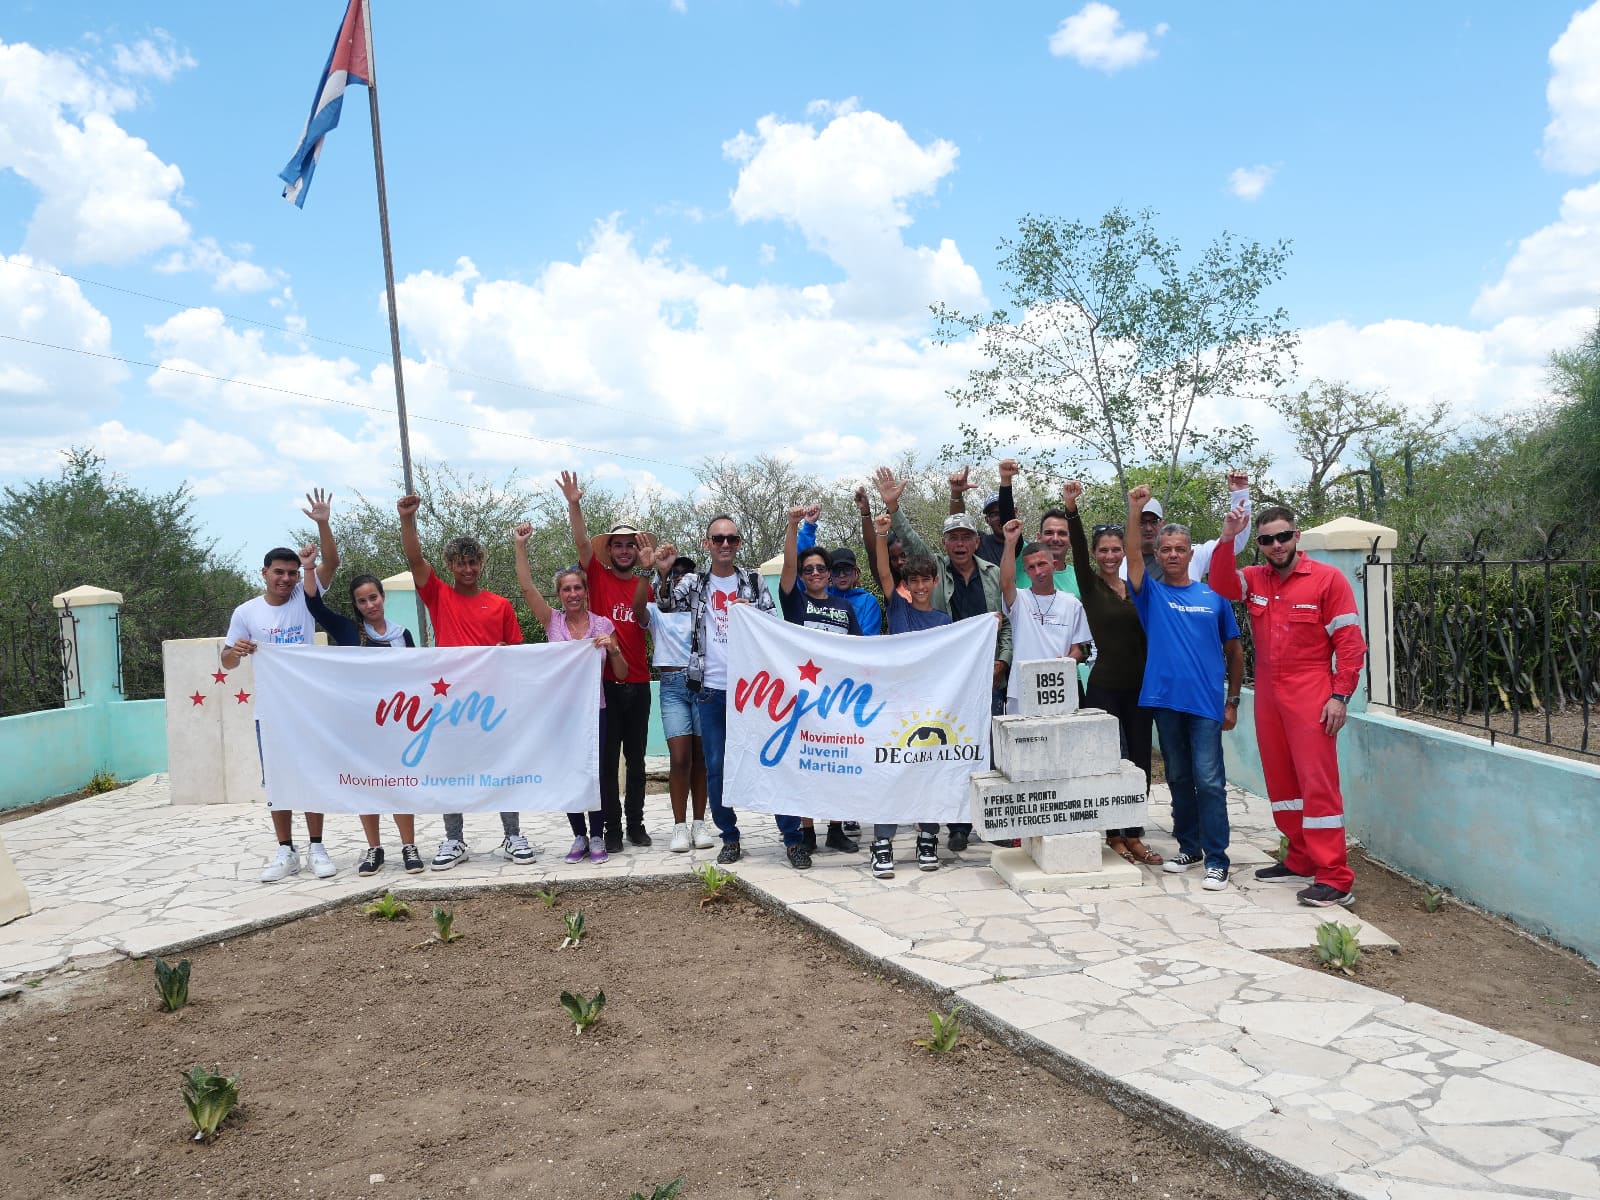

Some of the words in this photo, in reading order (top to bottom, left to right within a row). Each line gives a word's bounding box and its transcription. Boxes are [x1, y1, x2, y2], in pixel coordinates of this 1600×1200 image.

[1036, 672, 1064, 688] 1895
[1037, 689, 1064, 704] 1995
[735, 659, 887, 768] mjm
[375, 677, 508, 768] mjm
[800, 729, 865, 745] Movimiento
[800, 745, 848, 759] Juvenil
[875, 747, 901, 764] DE
[903, 751, 933, 765] CARA
[800, 758, 863, 775] Martiano
[339, 773, 419, 787] Movimiento
[421, 774, 475, 787] Juvenil
[479, 774, 543, 787] Martiano
[984, 797, 989, 806] Y
[991, 794, 1014, 804] PENSE
[1016, 793, 1026, 802] DE
[1028, 790, 1057, 801] PRONTO
[984, 809, 1002, 817] ANTE
[1005, 803, 1038, 816] AQUELLA
[1040, 800, 1081, 812] HERMOSURA
[1083, 798, 1094, 808] EN
[1095, 797, 1109, 806] LAS
[1111, 794, 1145, 805] PASIONES
[984, 817, 1009, 830] BAJAS
[1010, 816, 1016, 827] Y
[1018, 813, 1052, 826] FEROCES
[1053, 811, 1068, 823] DEL
[1070, 809, 1099, 821] HOMBRE
